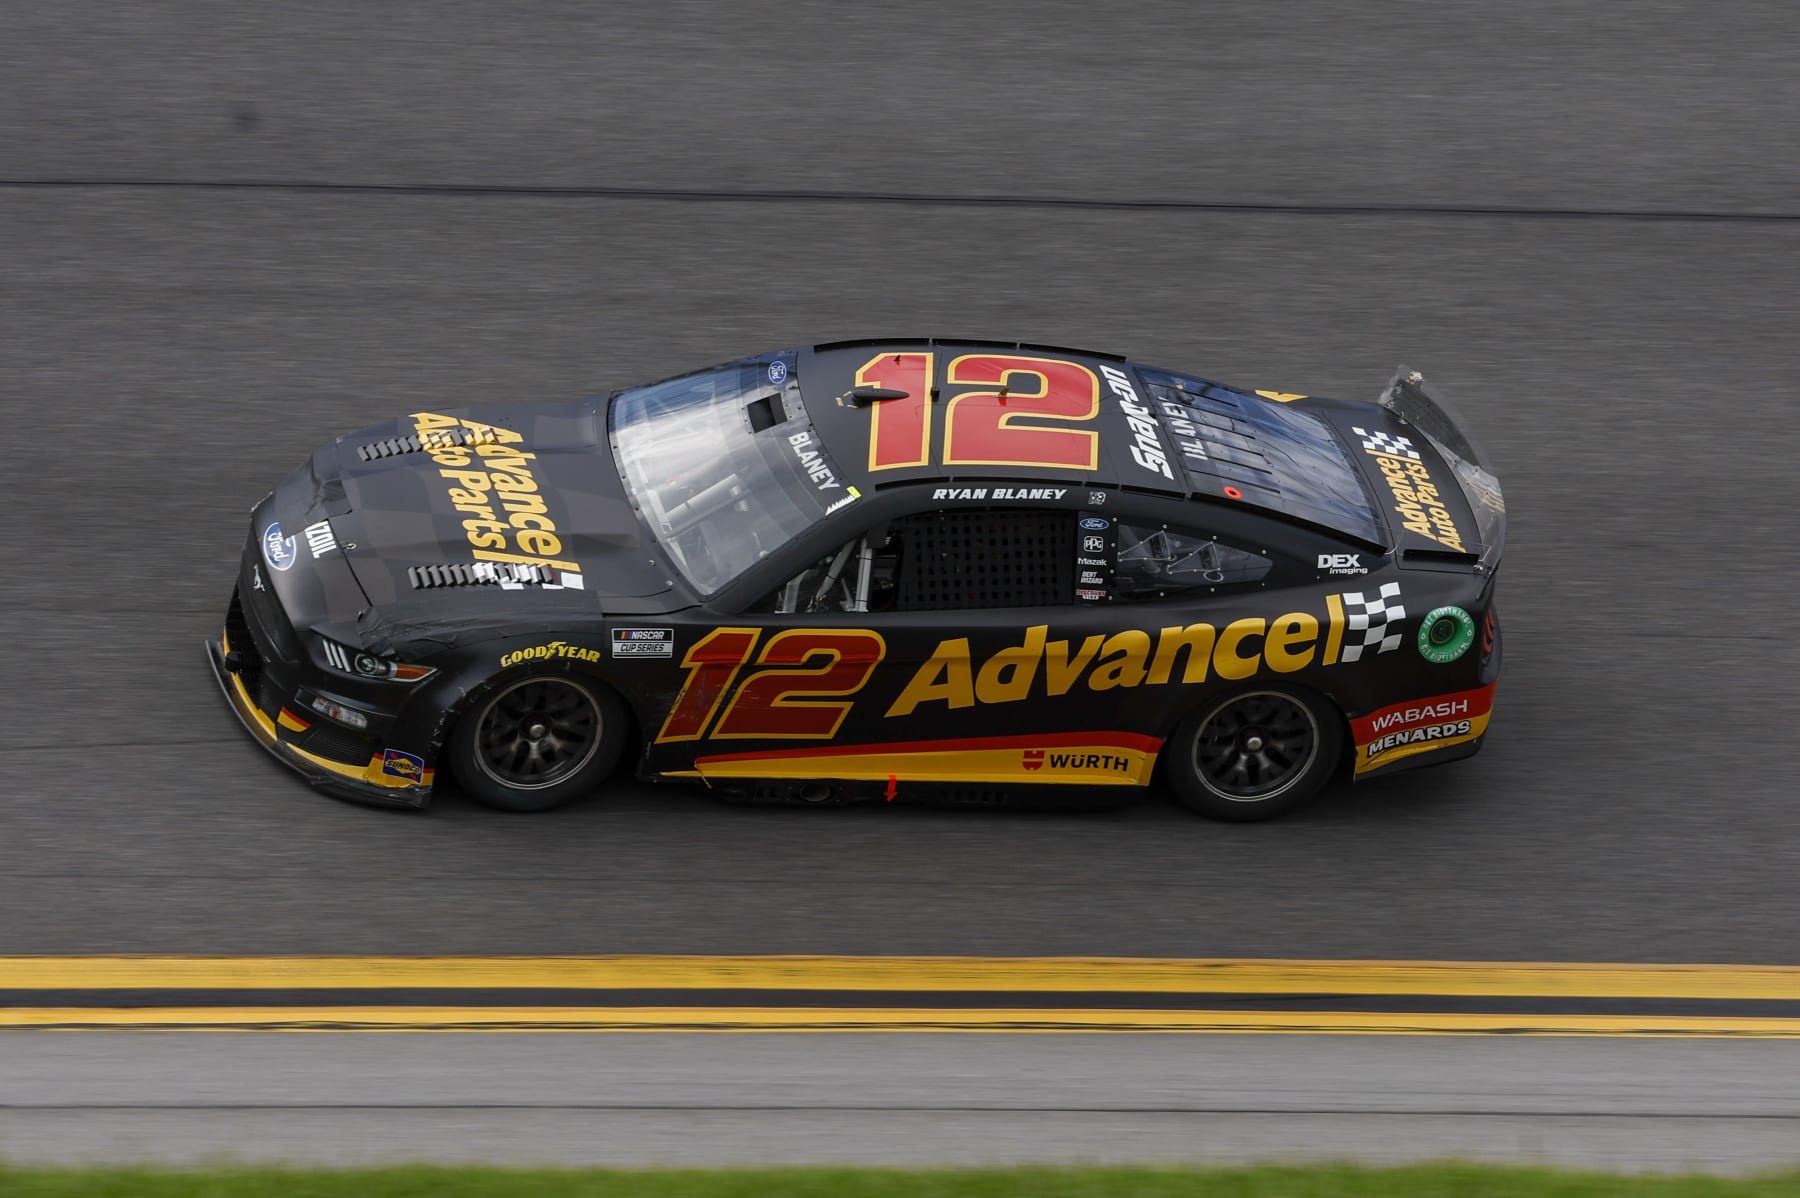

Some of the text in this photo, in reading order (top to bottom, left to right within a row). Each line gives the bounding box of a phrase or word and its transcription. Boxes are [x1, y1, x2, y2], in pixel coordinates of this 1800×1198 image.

[855, 352, 1100, 472] 12
[1099, 365, 1175, 480] Snap-on
[788, 431, 840, 491] BLANEY
[460, 419, 562, 556] Advance
[932, 488, 1067, 500] RYAN BLANEY
[1376, 457, 1438, 541] Advance
[439, 469, 510, 550] Parts
[1404, 463, 1467, 553] Auto Parts
[1082, 518, 1107, 529] Ford
[1085, 537, 1104, 550] PPG
[1078, 558, 1107, 566] Mazak
[1318, 554, 1360, 568] DEX
[1329, 567, 1368, 575] imaging
[620, 643, 665, 652] CUP SERIES
[631, 631, 665, 640] NASCAR
[500, 641, 601, 668] GOODYEAR
[884, 611, 1319, 718] Advance
[654, 627, 887, 745] 12
[1372, 699, 1469, 733] WABASH
[1368, 720, 1472, 757] MENARDS
[385, 759, 422, 774] SUNOCO
[1049, 753, 1129, 772] WÜRTH
